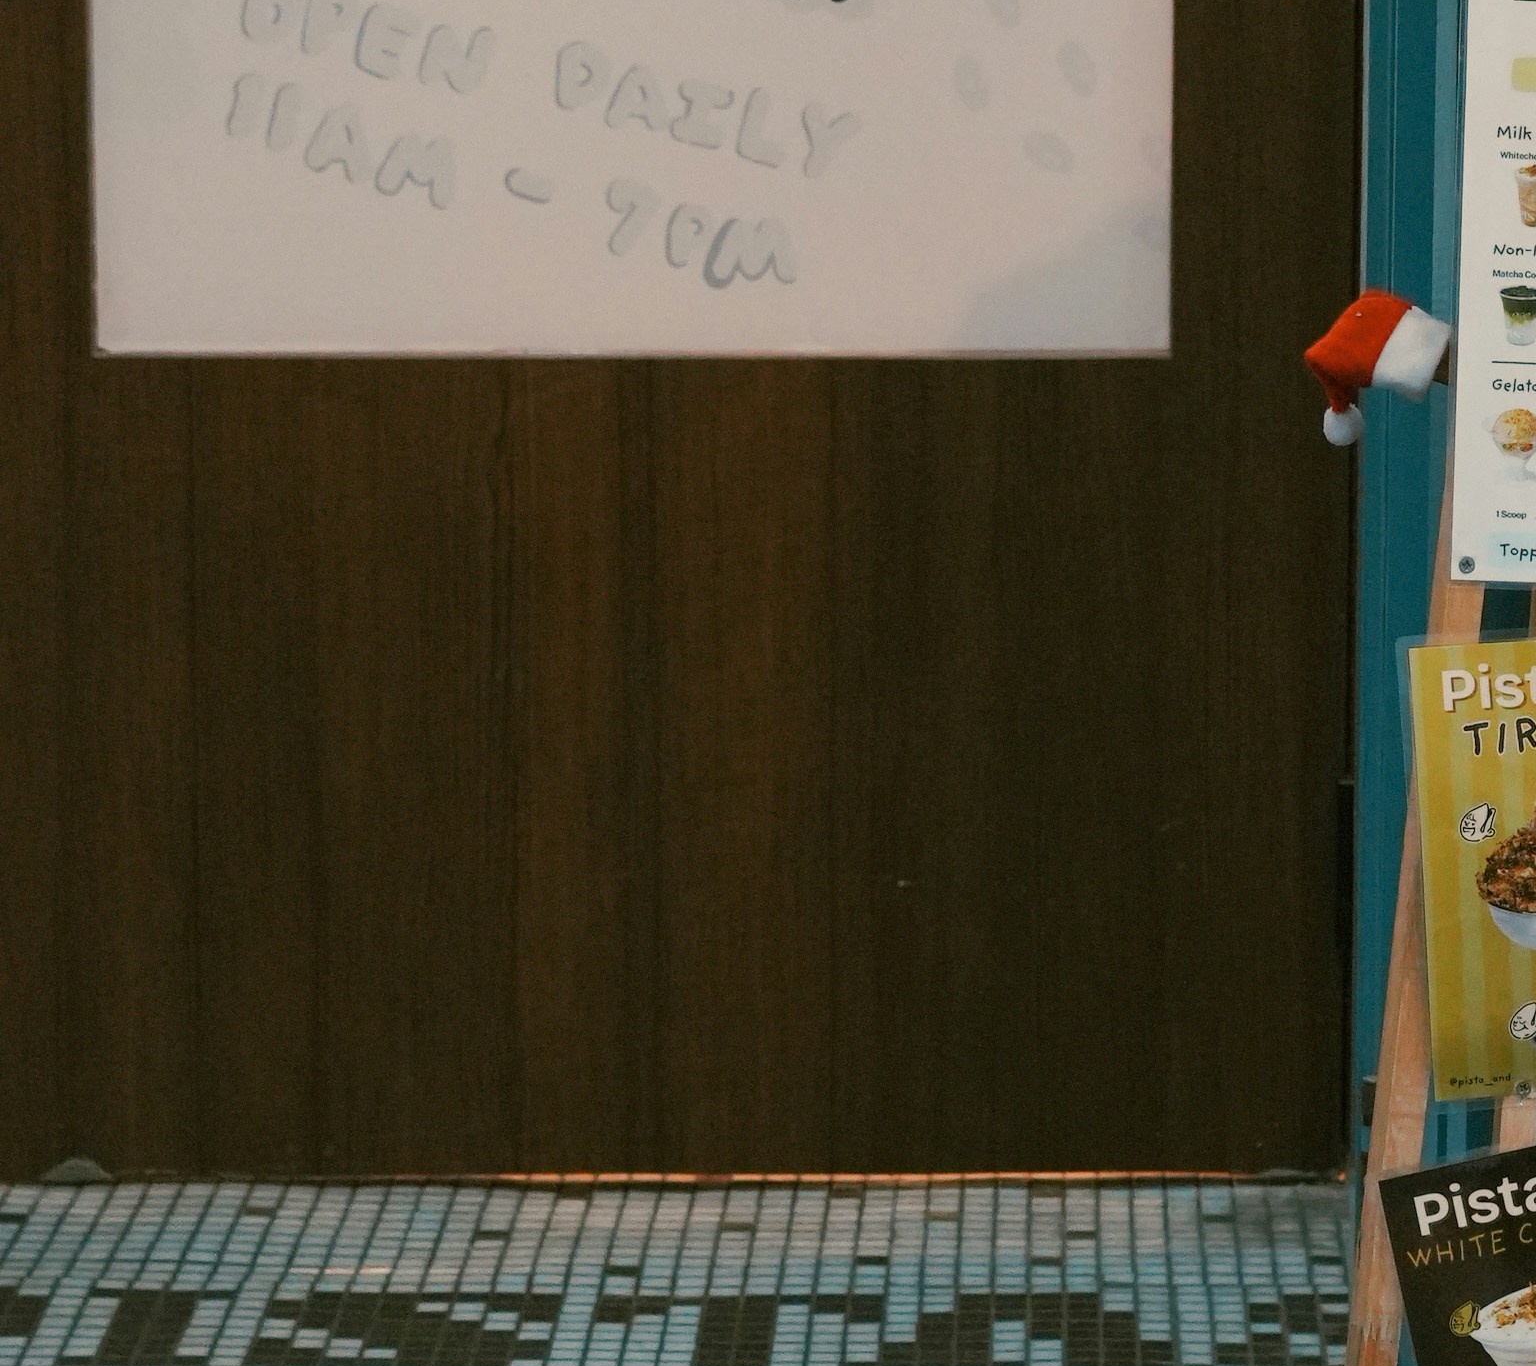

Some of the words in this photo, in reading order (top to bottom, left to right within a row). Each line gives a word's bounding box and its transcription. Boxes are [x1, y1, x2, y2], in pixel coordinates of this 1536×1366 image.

[553, 38, 858, 177] DAILY
[1497, 125, 1532, 141] Milk
[1493, 270, 1523, 278] Matcha
[1501, 511, 1527, 519] Scoop
[1407, 1228, 1506, 1269] WHITE
